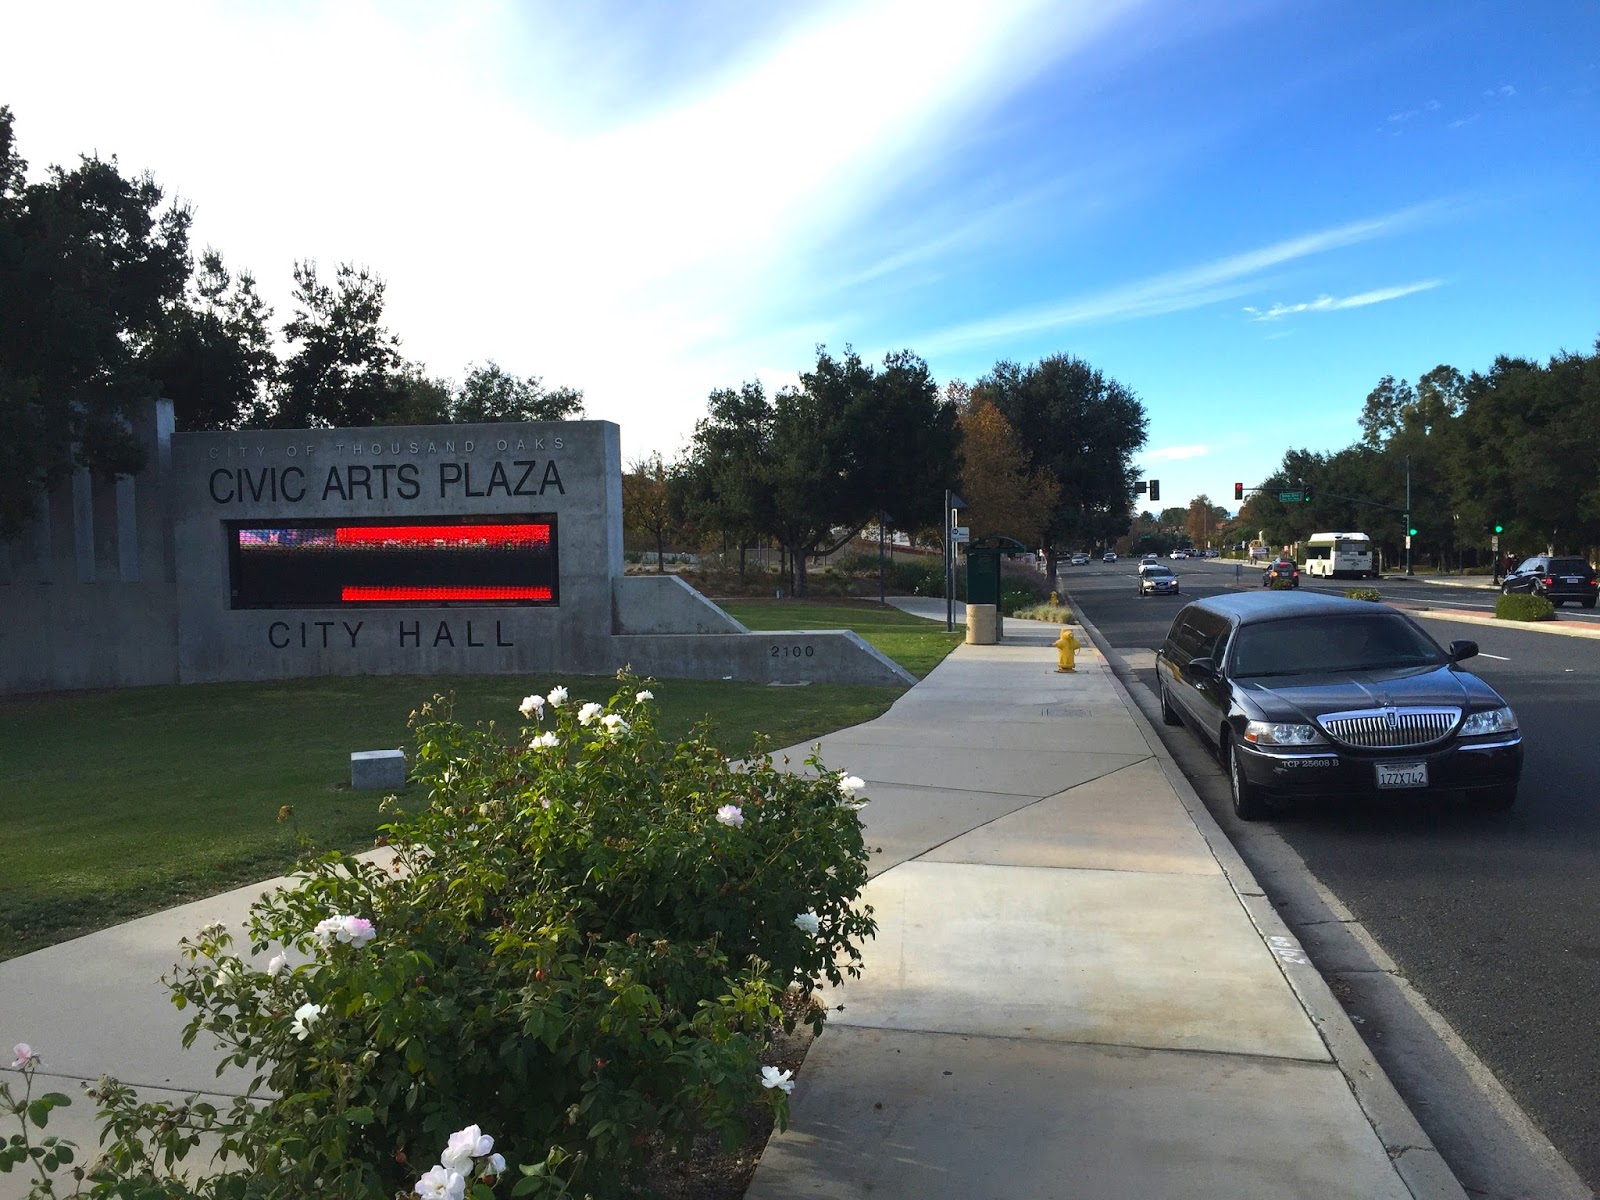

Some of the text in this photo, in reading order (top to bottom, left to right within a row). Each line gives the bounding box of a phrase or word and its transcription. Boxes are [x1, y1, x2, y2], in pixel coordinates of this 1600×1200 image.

[210, 437, 565, 459] CITY OF THOUSAND OAKS
[209, 459, 565, 504] CIVIC ARTS PLAZA
[268, 620, 514, 649] CITY HALL
[771, 645, 814, 658] 2100
[1302, 760, 1330, 768] 25608
[1332, 759, 1340, 767] B
